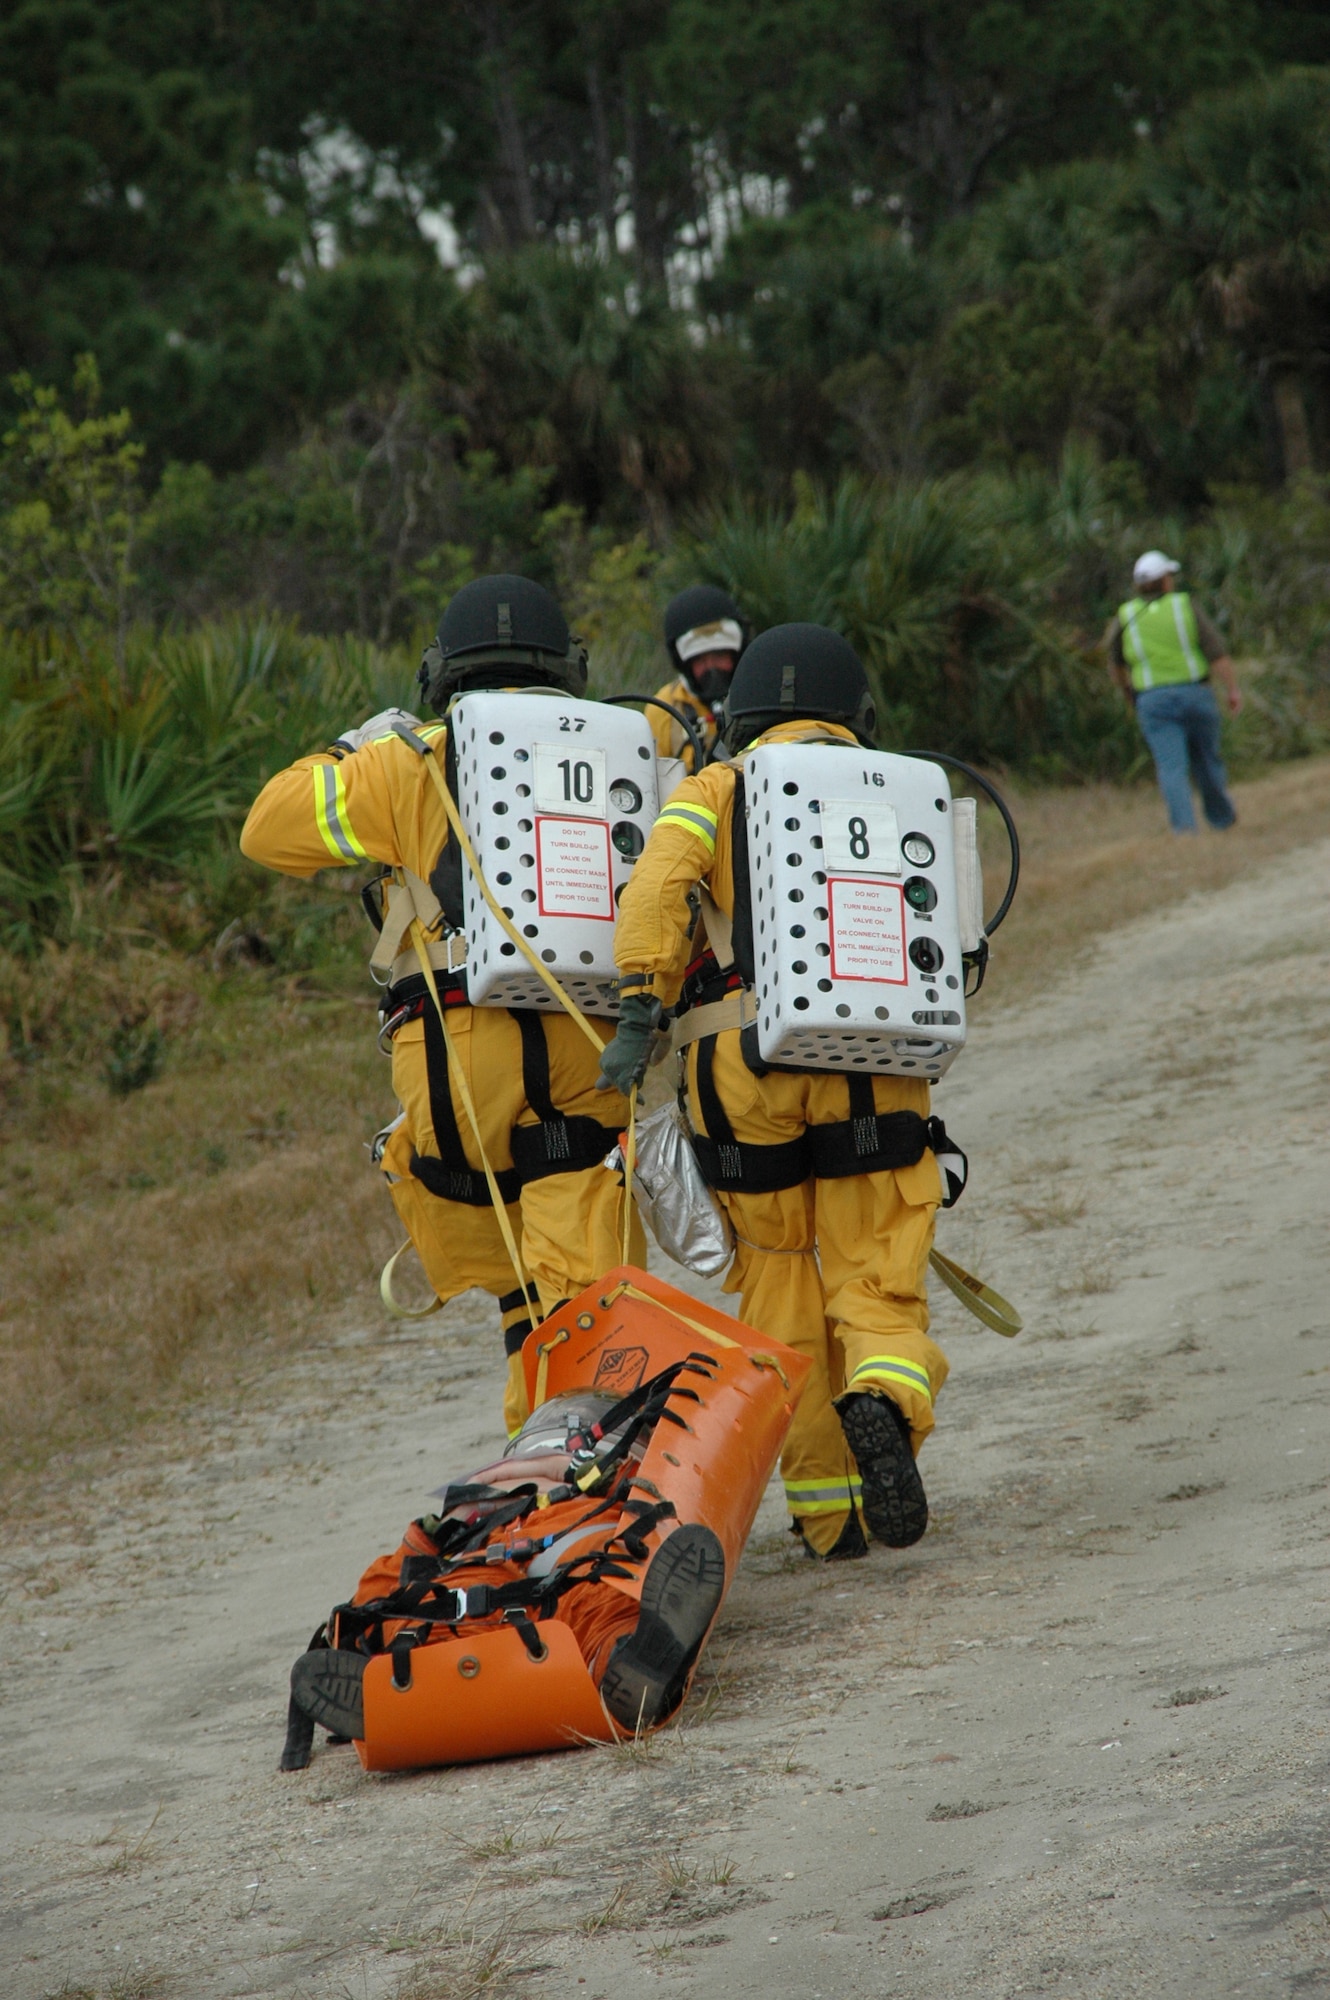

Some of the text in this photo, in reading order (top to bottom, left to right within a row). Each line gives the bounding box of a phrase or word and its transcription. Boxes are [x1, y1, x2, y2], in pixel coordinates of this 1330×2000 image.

[559, 716, 587, 732] 27
[557, 759, 593, 803] 10
[863, 770, 885, 788] 16
[848, 816, 870, 860] 8
[570, 842, 599, 850] BUILD-UP
[566, 881, 607, 890] IMMEDIATELY
[863, 905, 892, 913] BUILD-UP
[849, 930, 880, 938] CONNECT
